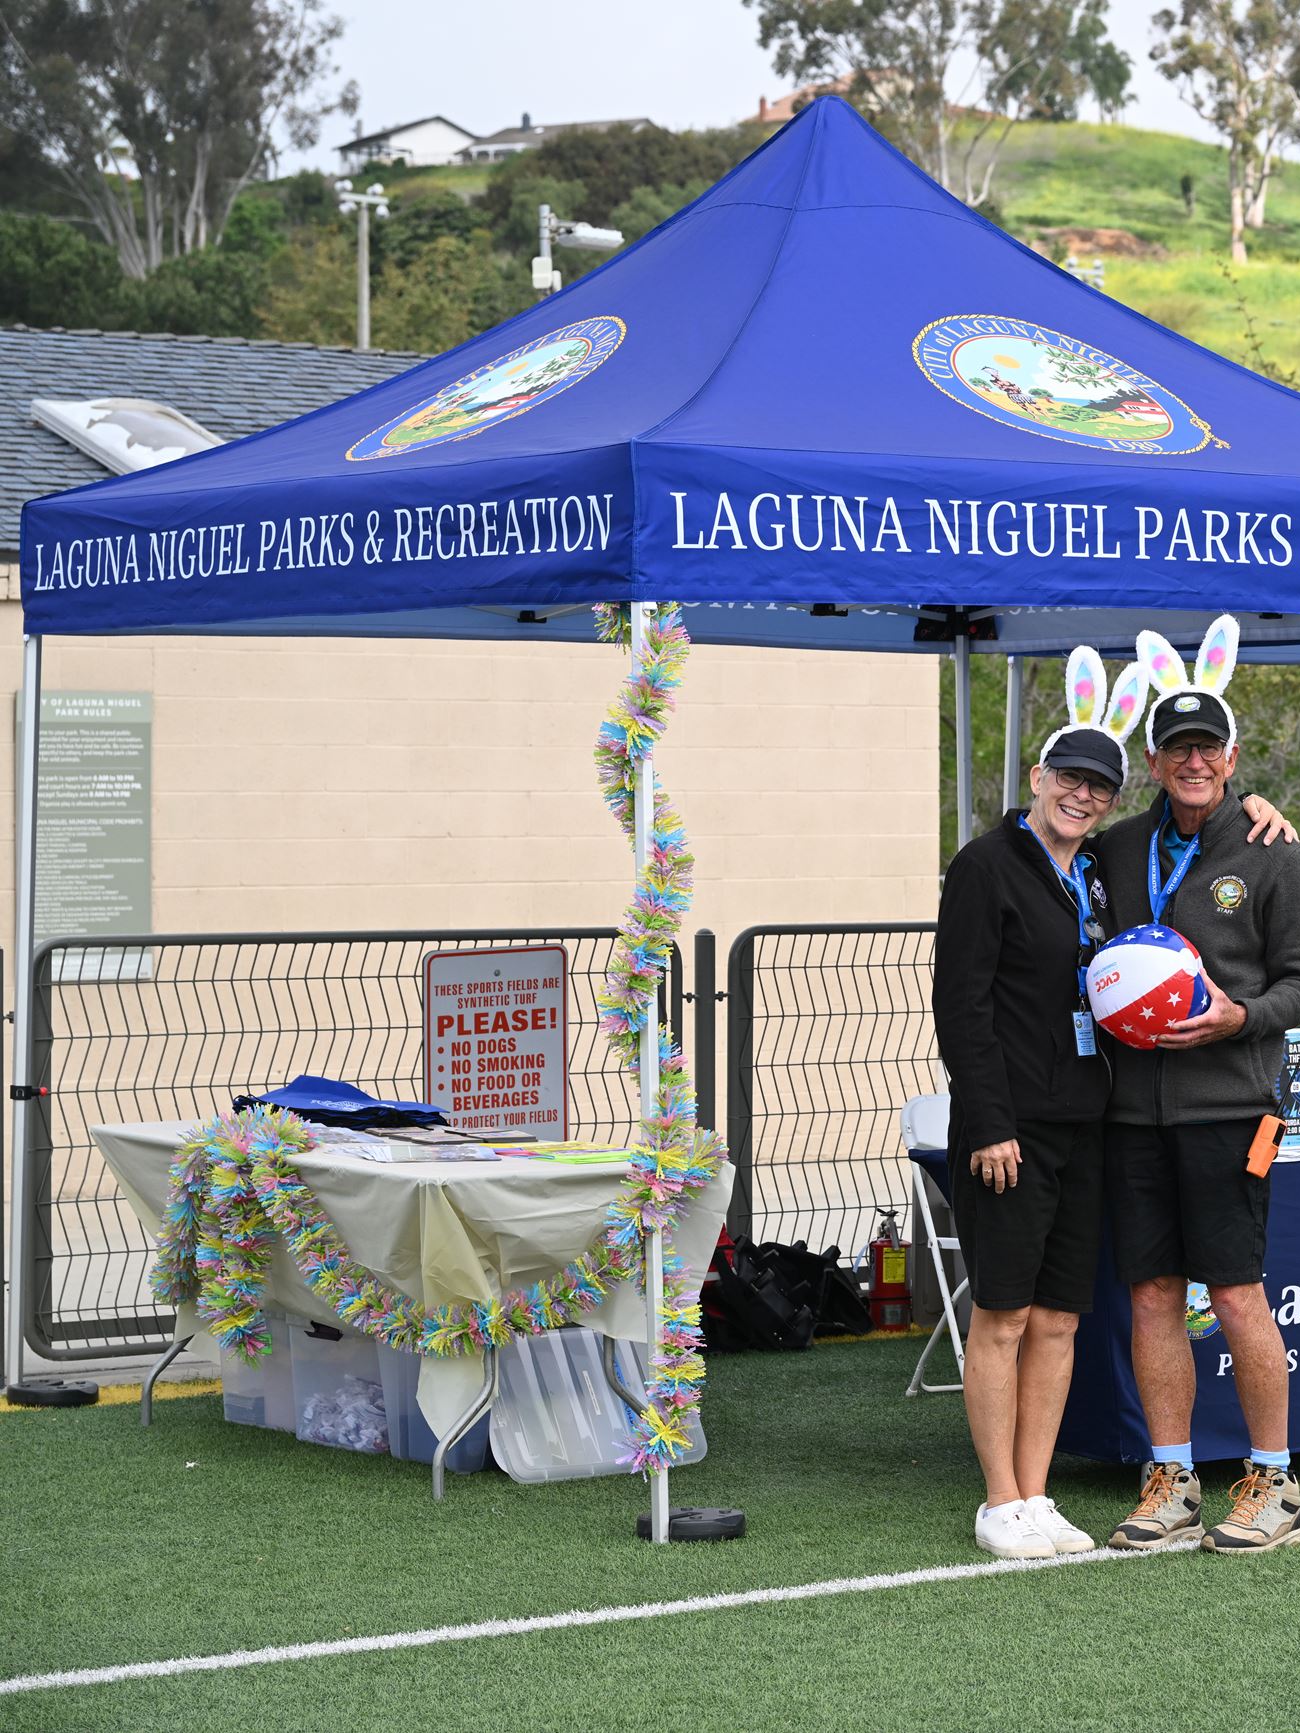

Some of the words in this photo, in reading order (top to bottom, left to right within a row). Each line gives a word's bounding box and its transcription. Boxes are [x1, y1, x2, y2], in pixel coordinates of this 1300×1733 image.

[923, 343, 954, 380] CITY
[949, 318, 1050, 343] LAGUNA
[1057, 336, 1158, 393] NIGUEL
[670, 491, 912, 554] LAGUNA
[924, 498, 1122, 560] NIGUEL
[1135, 505, 1293, 567] PARKS
[34, 536, 141, 592] LAGUNA
[146, 523, 250, 583] NIGUEL
[257, 511, 355, 571] PARKS
[363, 509, 383, 564] &
[393, 493, 613, 563] RECREATION
[55, 708, 80, 716] PARK
[108, 699, 141, 707] NIGUEL
[434, 984, 463, 996] THESE
[467, 981, 503, 995] SPORTS
[507, 979, 539, 992] FIELDS
[542, 977, 560, 989] ARE
[457, 994, 510, 1009] SYNTHETIC
[514, 993, 537, 1005] TURF
[437, 1007, 557, 1037] PLEASE!
[451, 1041, 471, 1057] NO
[477, 1037, 517, 1054] DOGS
[451, 1059, 471, 1075] NO
[477, 1053, 545, 1073] SMOKING
[451, 1078, 471, 1093] NO
[477, 1074, 516, 1091] FOOD
[521, 1072, 541, 1088] OR
[453, 1090, 539, 1112] BEVERAGES
[462, 1114, 499, 1128] PROTECT
[504, 1112, 526, 1126] YOUR
[529, 1109, 558, 1123] FIELDS
